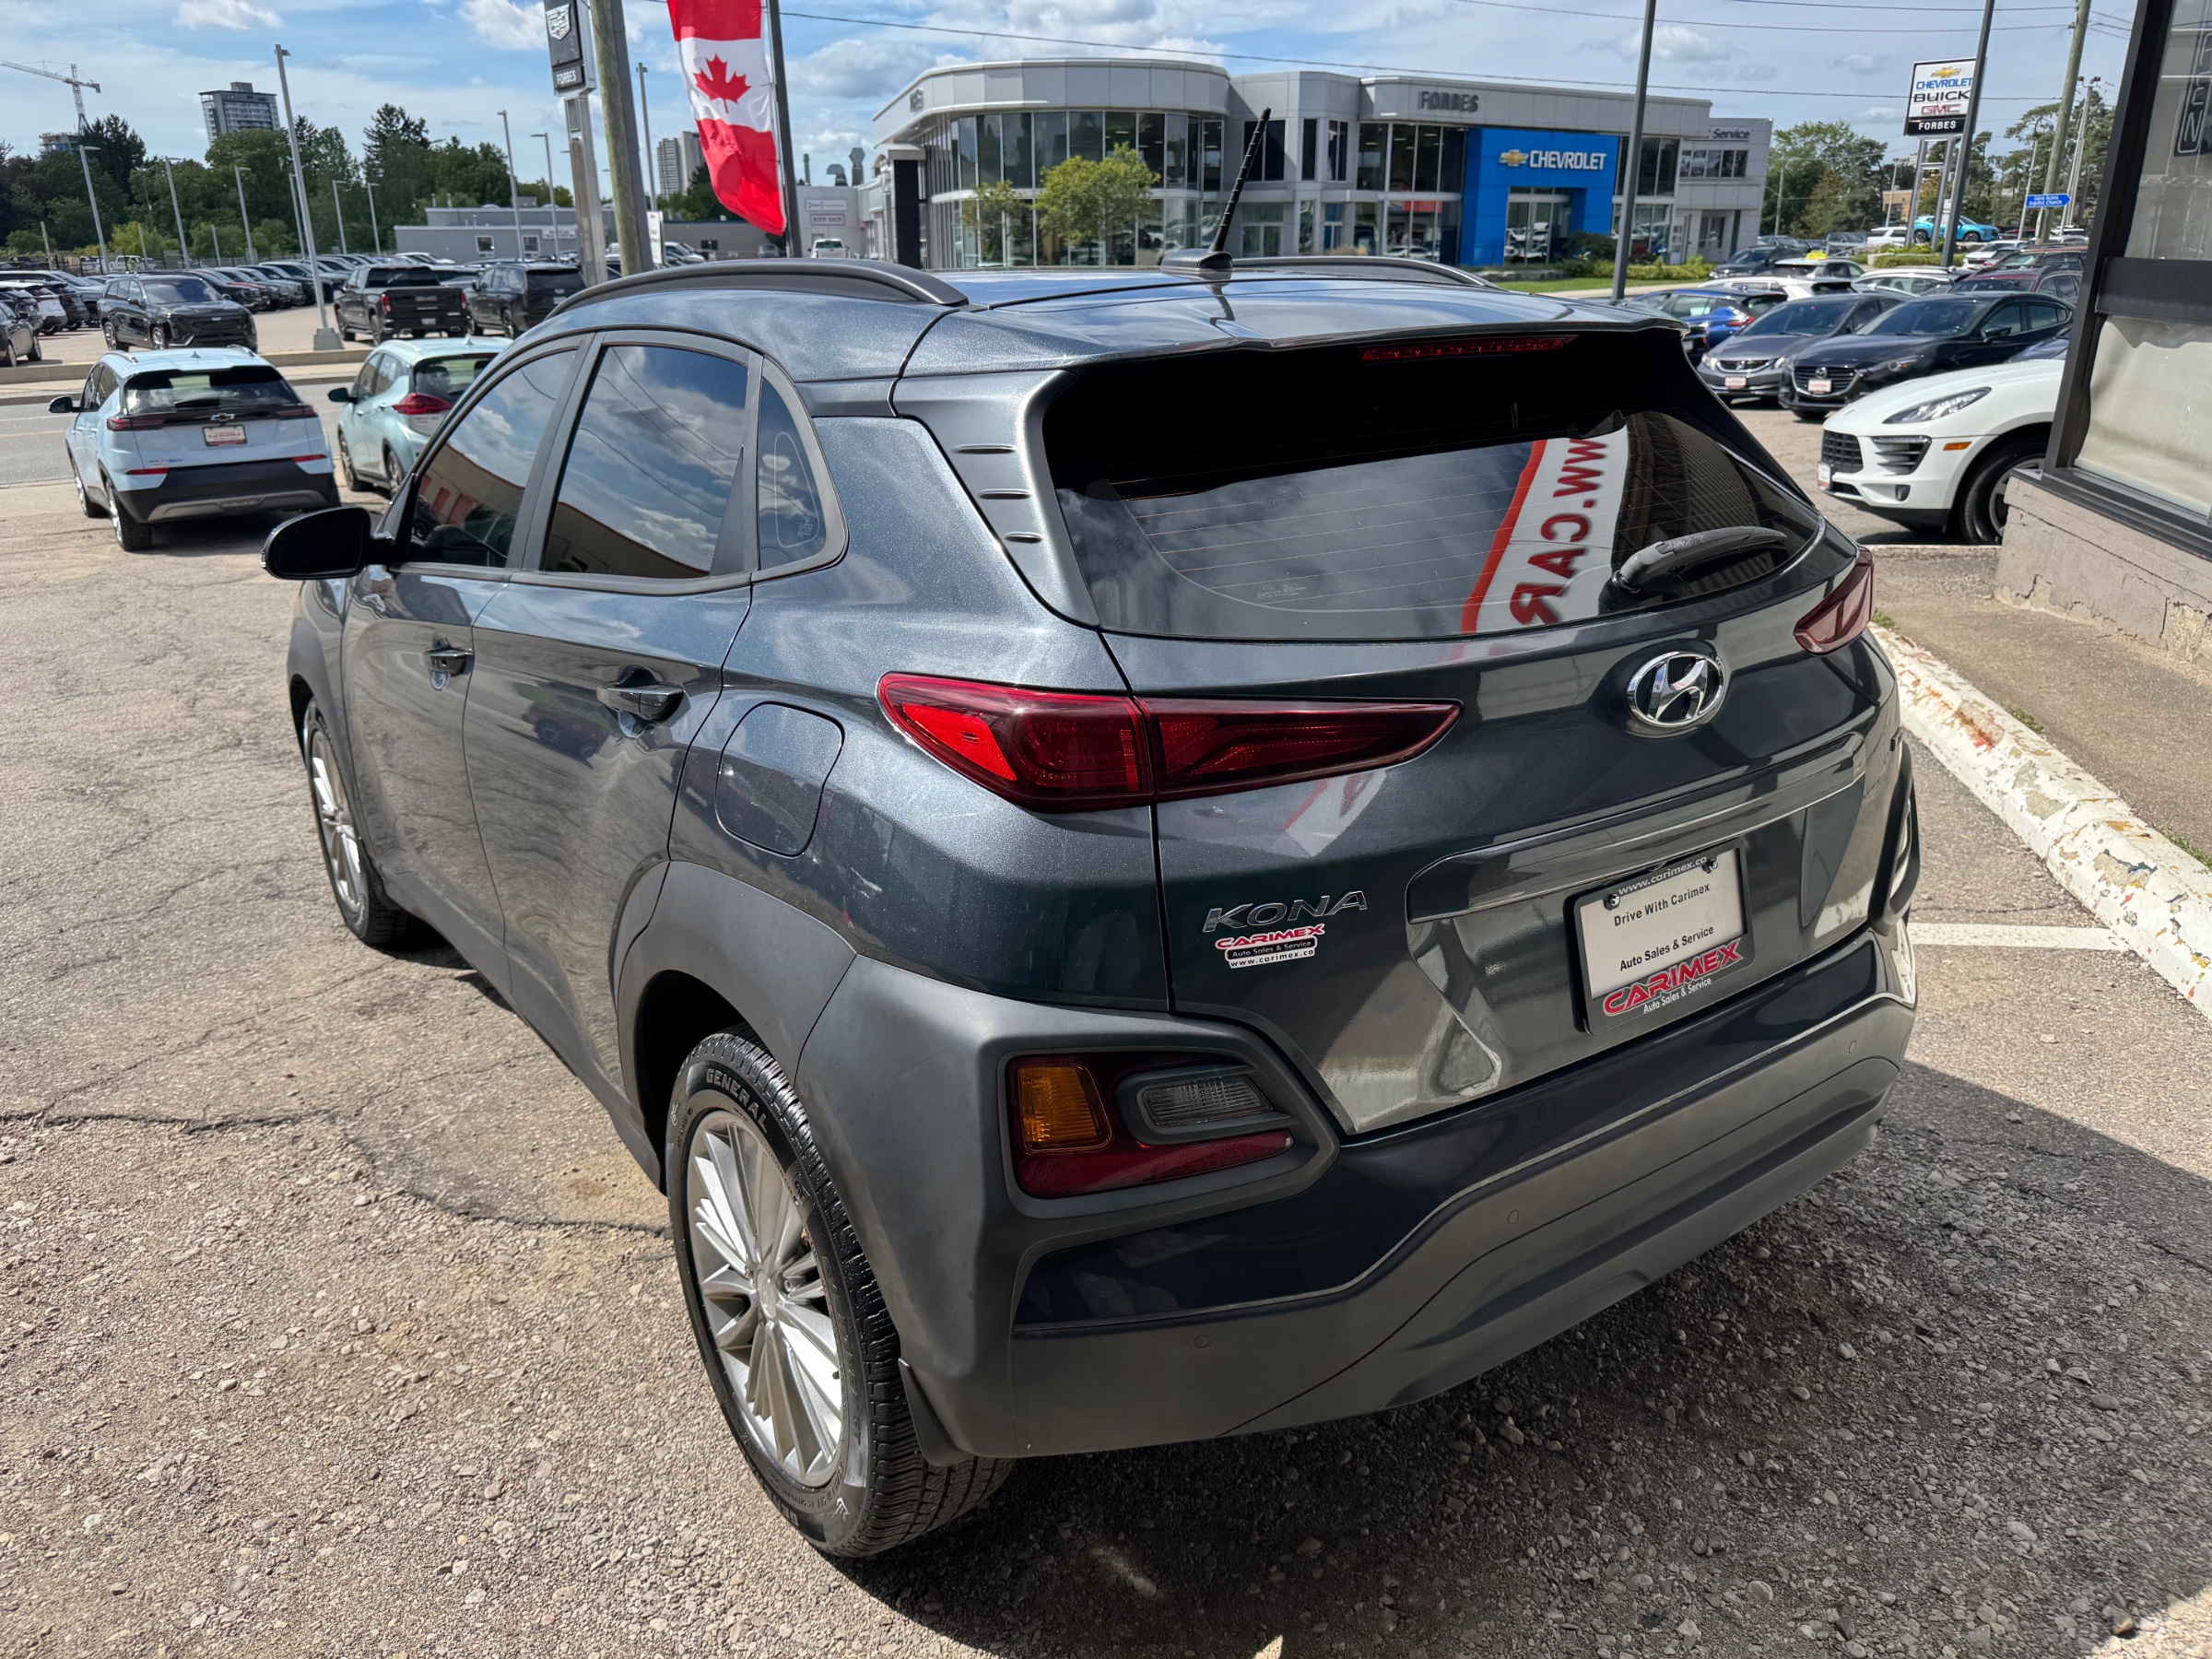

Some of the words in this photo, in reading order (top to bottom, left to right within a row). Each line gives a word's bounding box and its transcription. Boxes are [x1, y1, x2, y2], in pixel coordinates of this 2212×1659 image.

[1916, 77, 1973, 89] CHEVROLET
[1419, 90, 1479, 112] FORBES
[1913, 89, 1971, 102] BUICK
[1920, 103, 1960, 114] GMC
[1712, 128, 1750, 139] Service
[1918, 121, 1957, 131] FORBES
[1529, 149, 1606, 171] CHEVROLET
[1618, 856, 1707, 896] www.carimex.ca
[1202, 890, 1368, 933] KONA
[1614, 909, 1642, 927] Drive
[1644, 899, 1669, 915] With
[1671, 882, 1711, 905] Carimex
[1216, 924, 1325, 949] CARIMEX
[1253, 947, 1274, 955] Sales
[1284, 940, 1312, 950] Service
[1230, 948, 1314, 968] www.carimex.ca
[1619, 955, 1642, 971] Auto
[1644, 944, 1670, 961] Sales
[1672, 939, 1680, 950] &
[1681, 926, 1714, 947] Service
[1603, 937, 1743, 1017] CARIMEX
[1643, 1000, 1660, 1015] Auto
[1661, 992, 1680, 1006] Sales
[1680, 986, 1687, 997] &
[1688, 977, 1712, 994] Service
[706, 1068, 768, 1134] GENERAL
